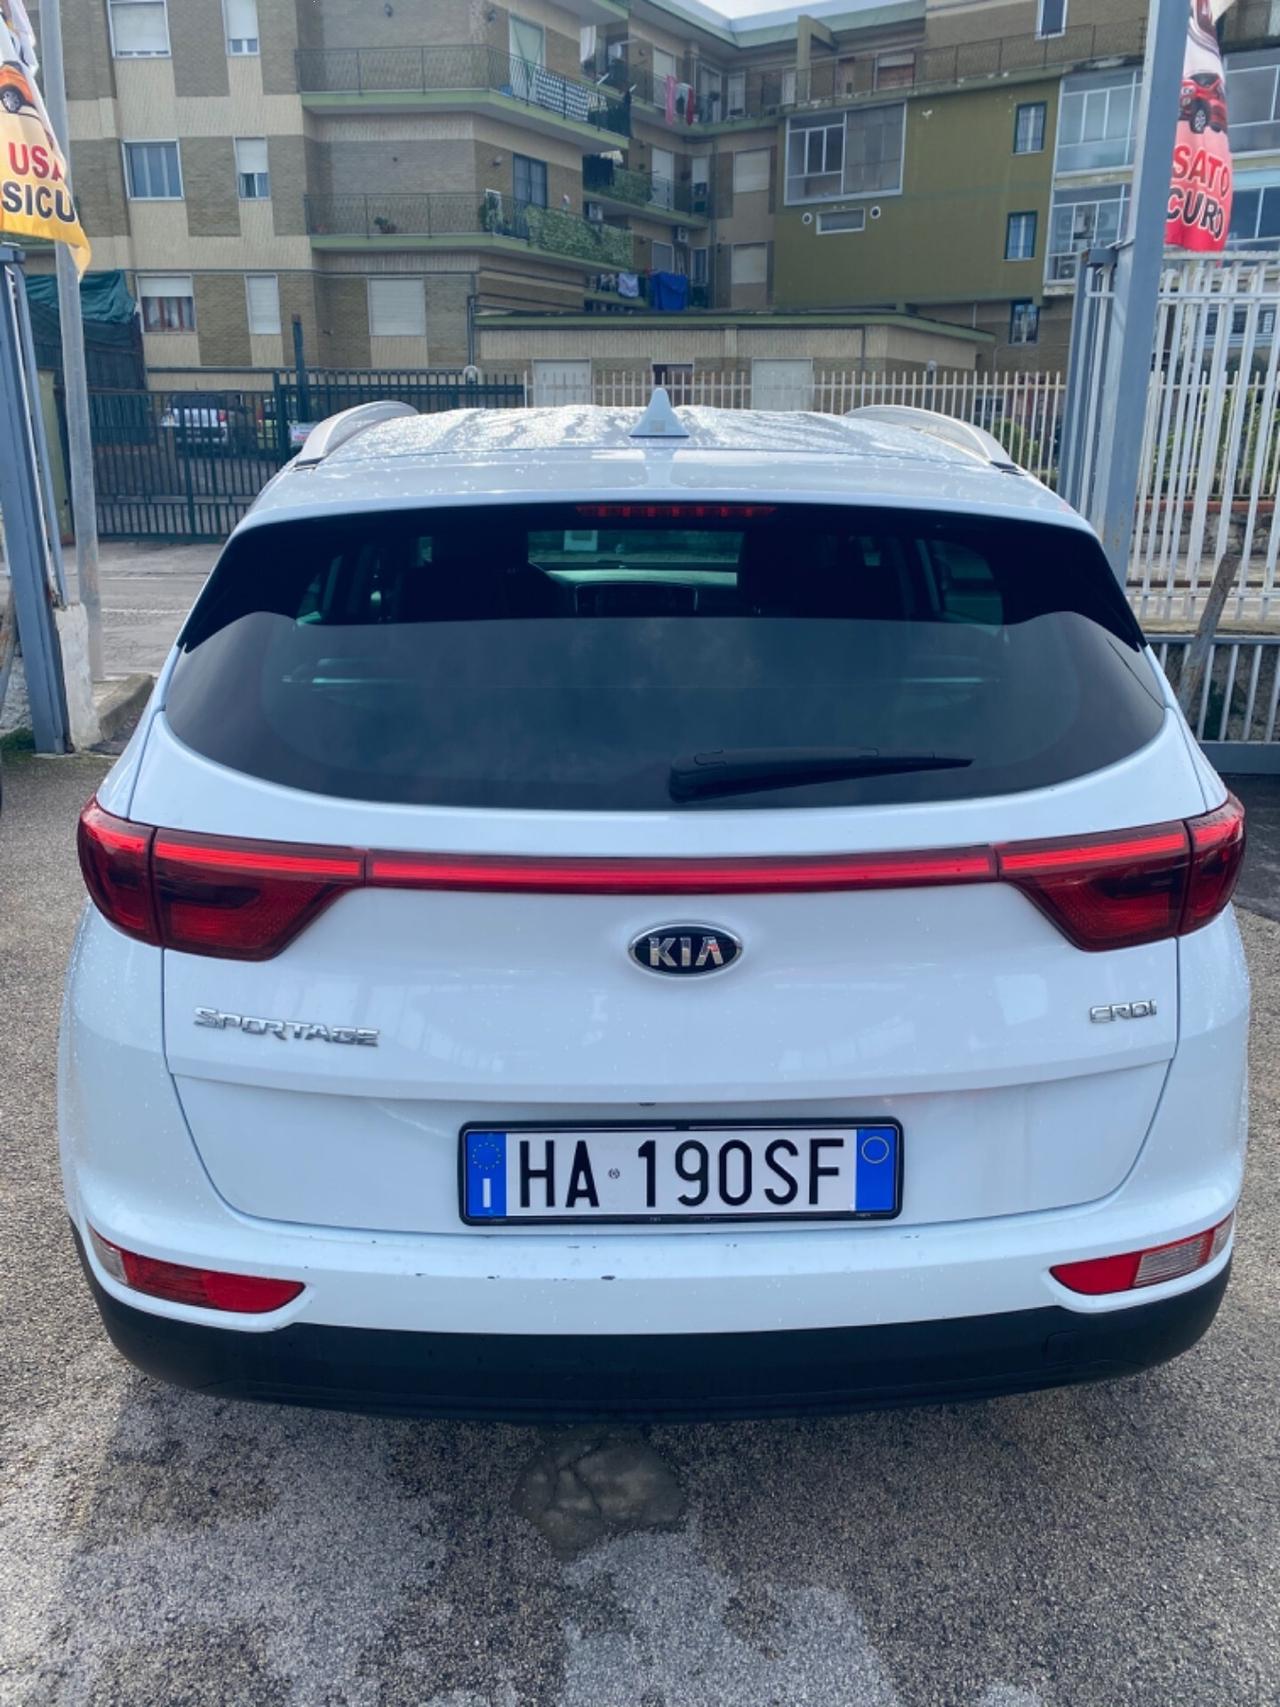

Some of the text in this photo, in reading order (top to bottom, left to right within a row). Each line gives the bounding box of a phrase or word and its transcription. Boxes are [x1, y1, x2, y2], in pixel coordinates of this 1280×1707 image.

[648, 936, 724, 967] KIA
[194, 1006, 379, 1047] SPORTAGE
[519, 1138, 844, 1208] HA 190SF
